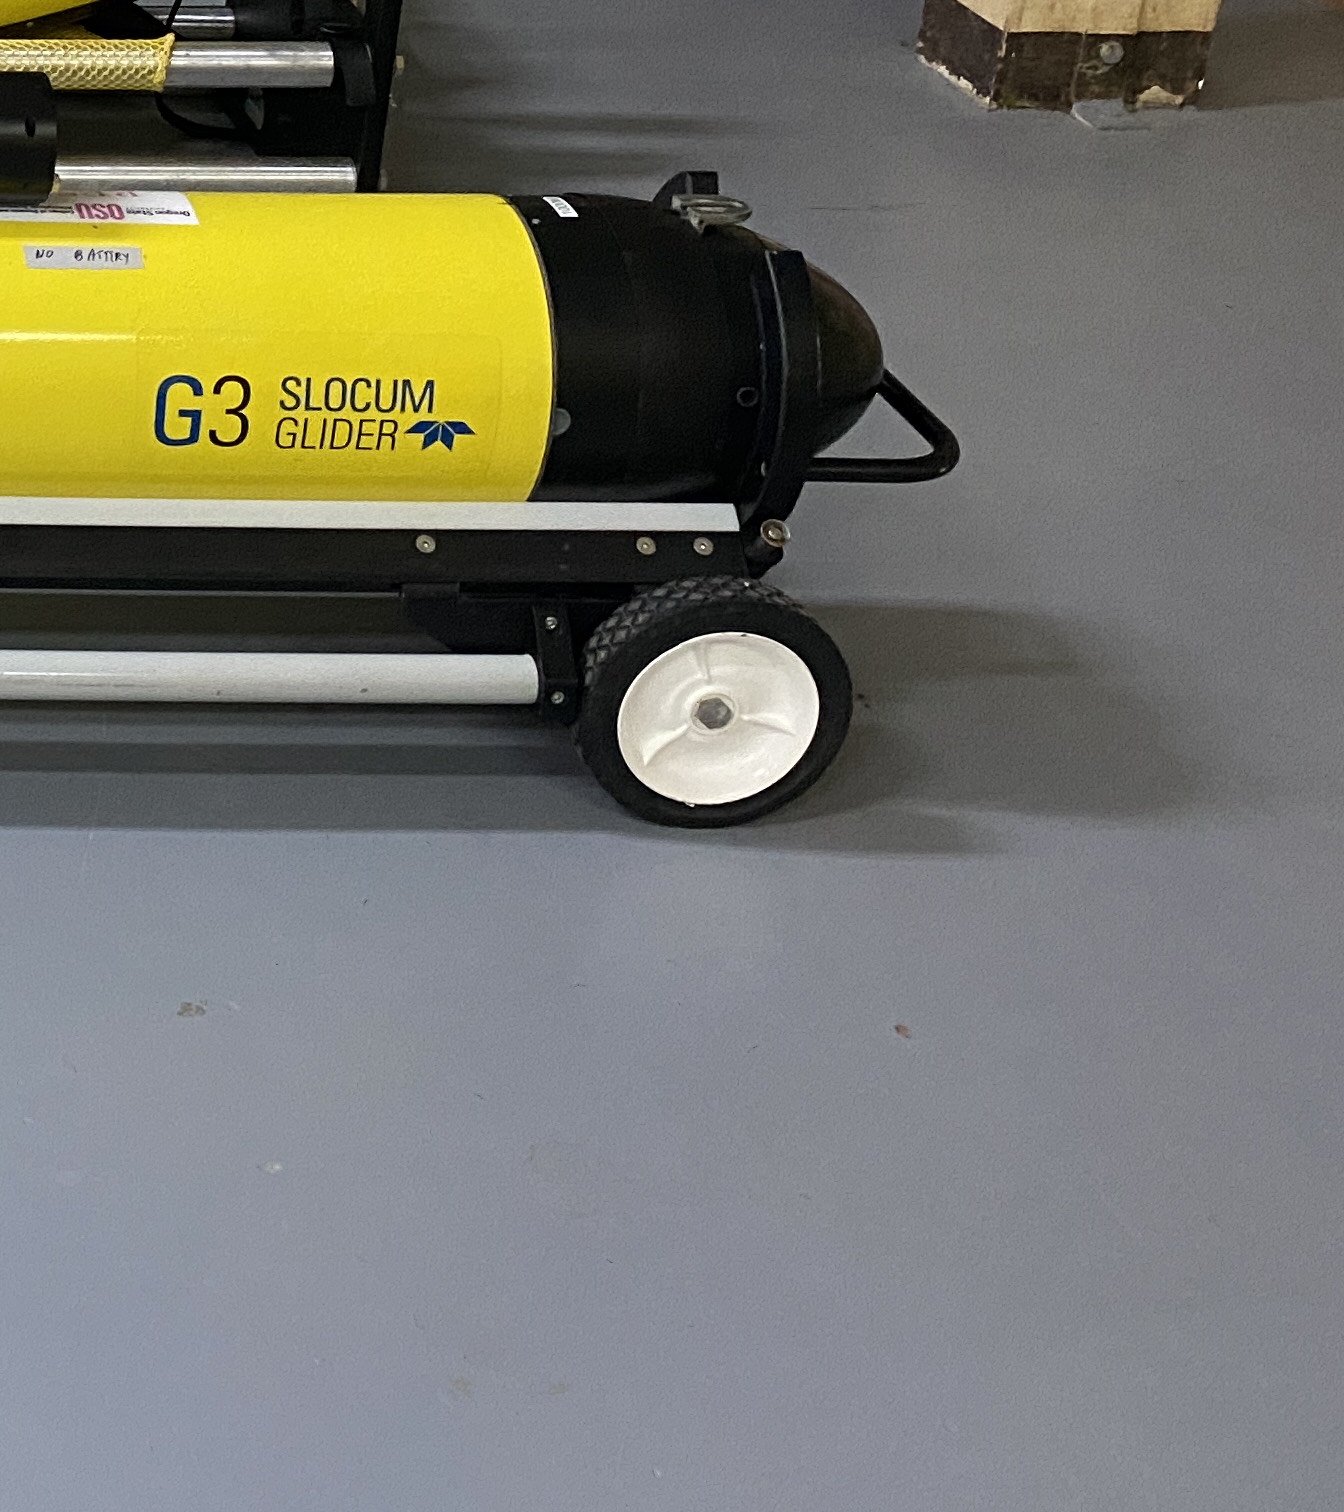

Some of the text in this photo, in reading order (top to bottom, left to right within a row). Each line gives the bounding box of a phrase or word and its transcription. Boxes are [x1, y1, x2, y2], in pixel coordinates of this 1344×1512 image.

[74, 202, 126, 220] OSU
[35, 248, 54, 260] NO
[153, 374, 252, 448] G3
[278, 375, 436, 414] SLOCUM
[274, 416, 399, 451] GLIDER
